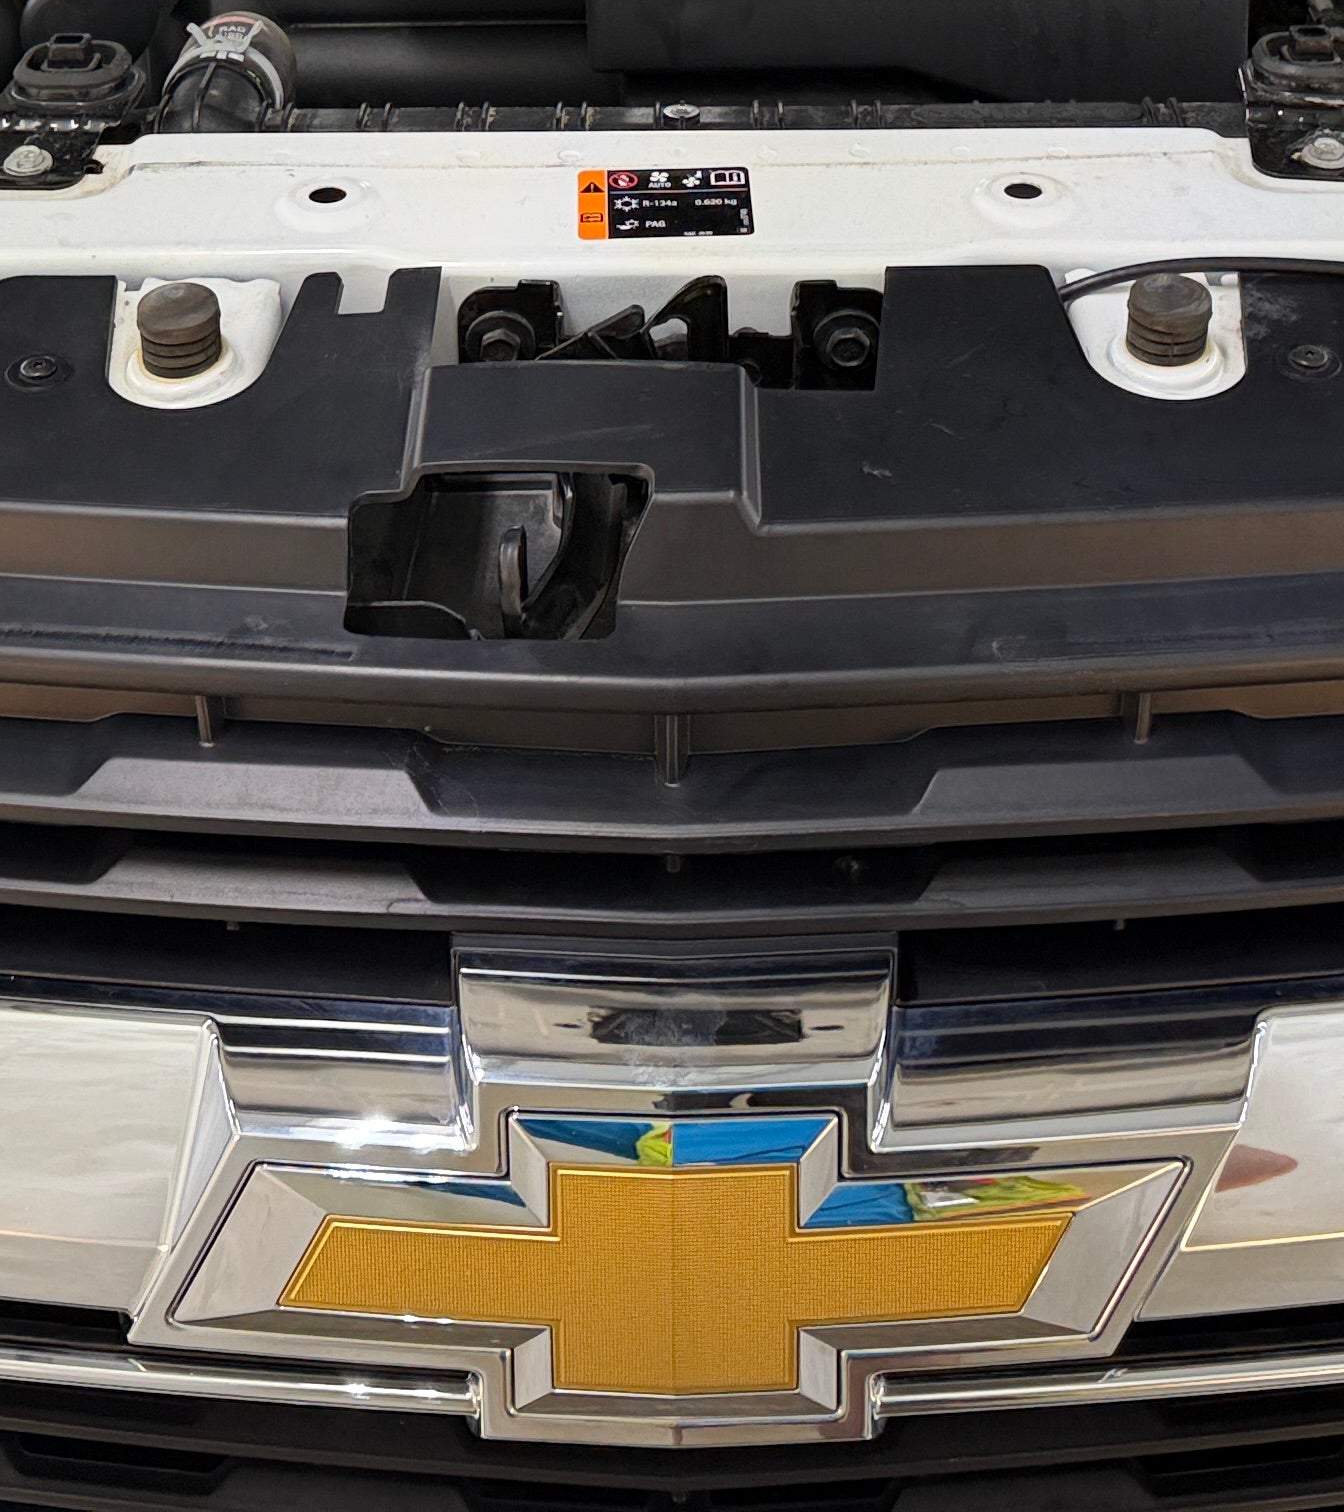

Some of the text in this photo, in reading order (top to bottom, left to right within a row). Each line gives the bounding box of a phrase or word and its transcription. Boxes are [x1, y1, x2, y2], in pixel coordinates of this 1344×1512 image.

[648, 181, 672, 189] AUTO
[642, 199, 678, 207] R-134a
[724, 197, 738, 206] kg
[645, 219, 667, 228] PAG
